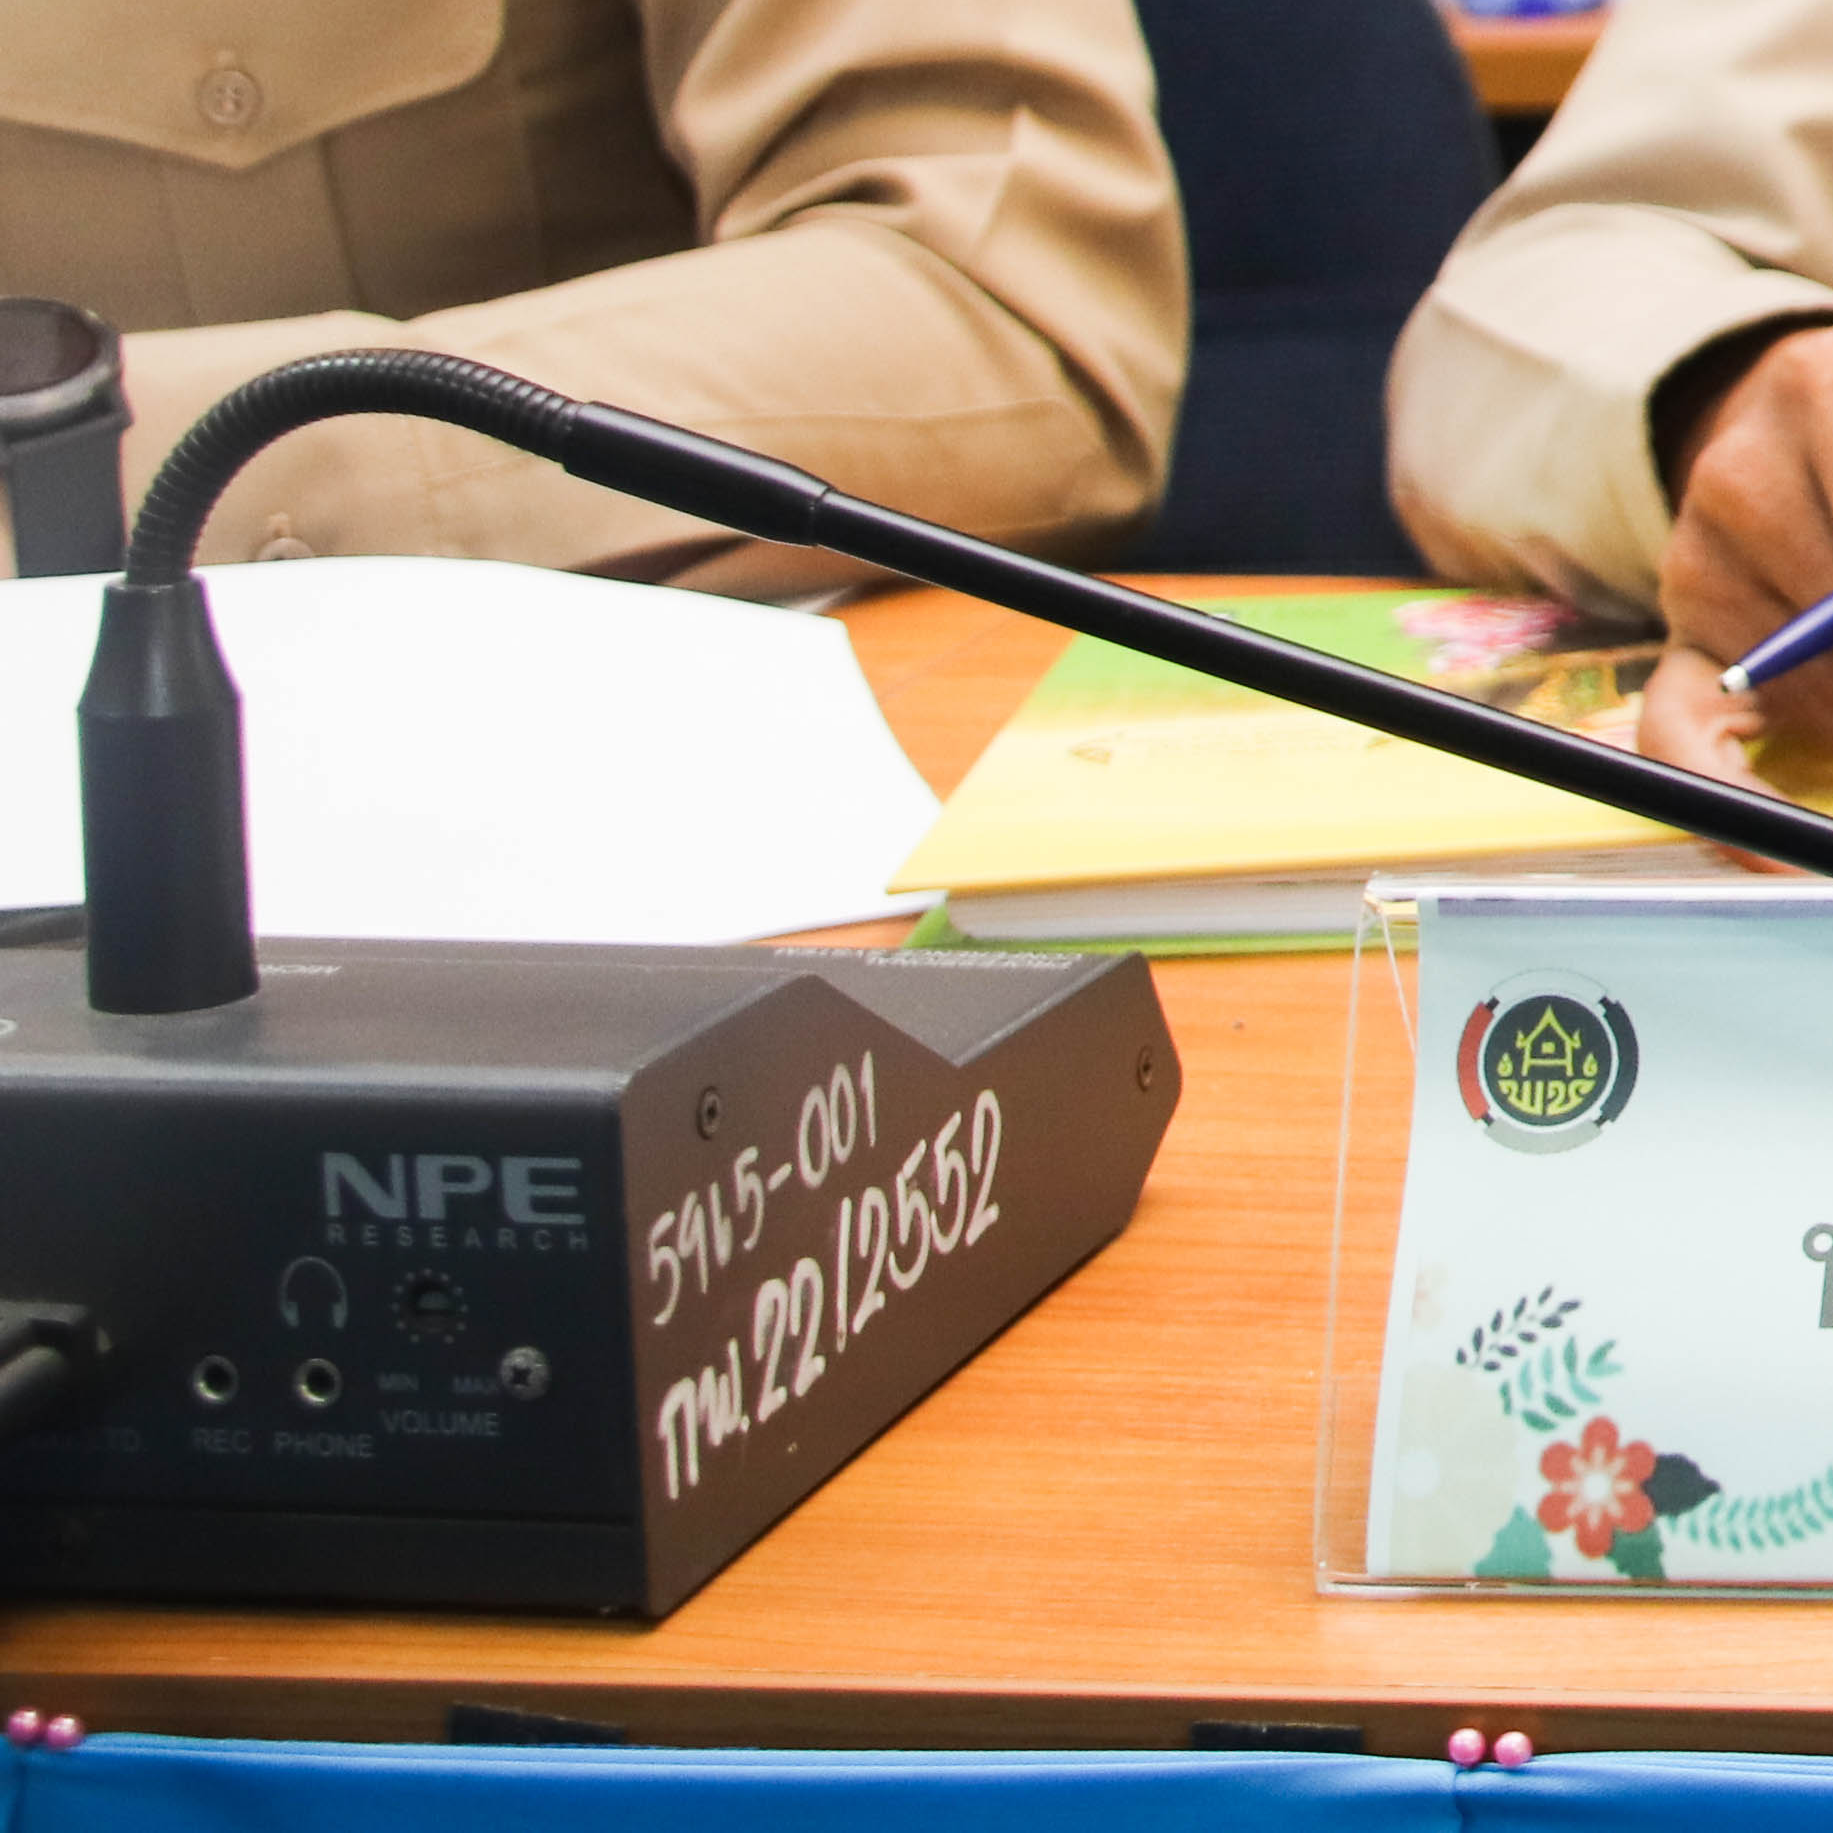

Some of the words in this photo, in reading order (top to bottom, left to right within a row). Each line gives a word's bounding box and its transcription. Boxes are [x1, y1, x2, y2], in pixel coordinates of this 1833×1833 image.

[321, 1152, 587, 1226] NPE
[326, 1224, 589, 1251] RESEARCH
[381, 1408, 500, 1438] VOLUME
[192, 1428, 251, 1455] REC
[273, 1431, 376, 1460] PHONE
